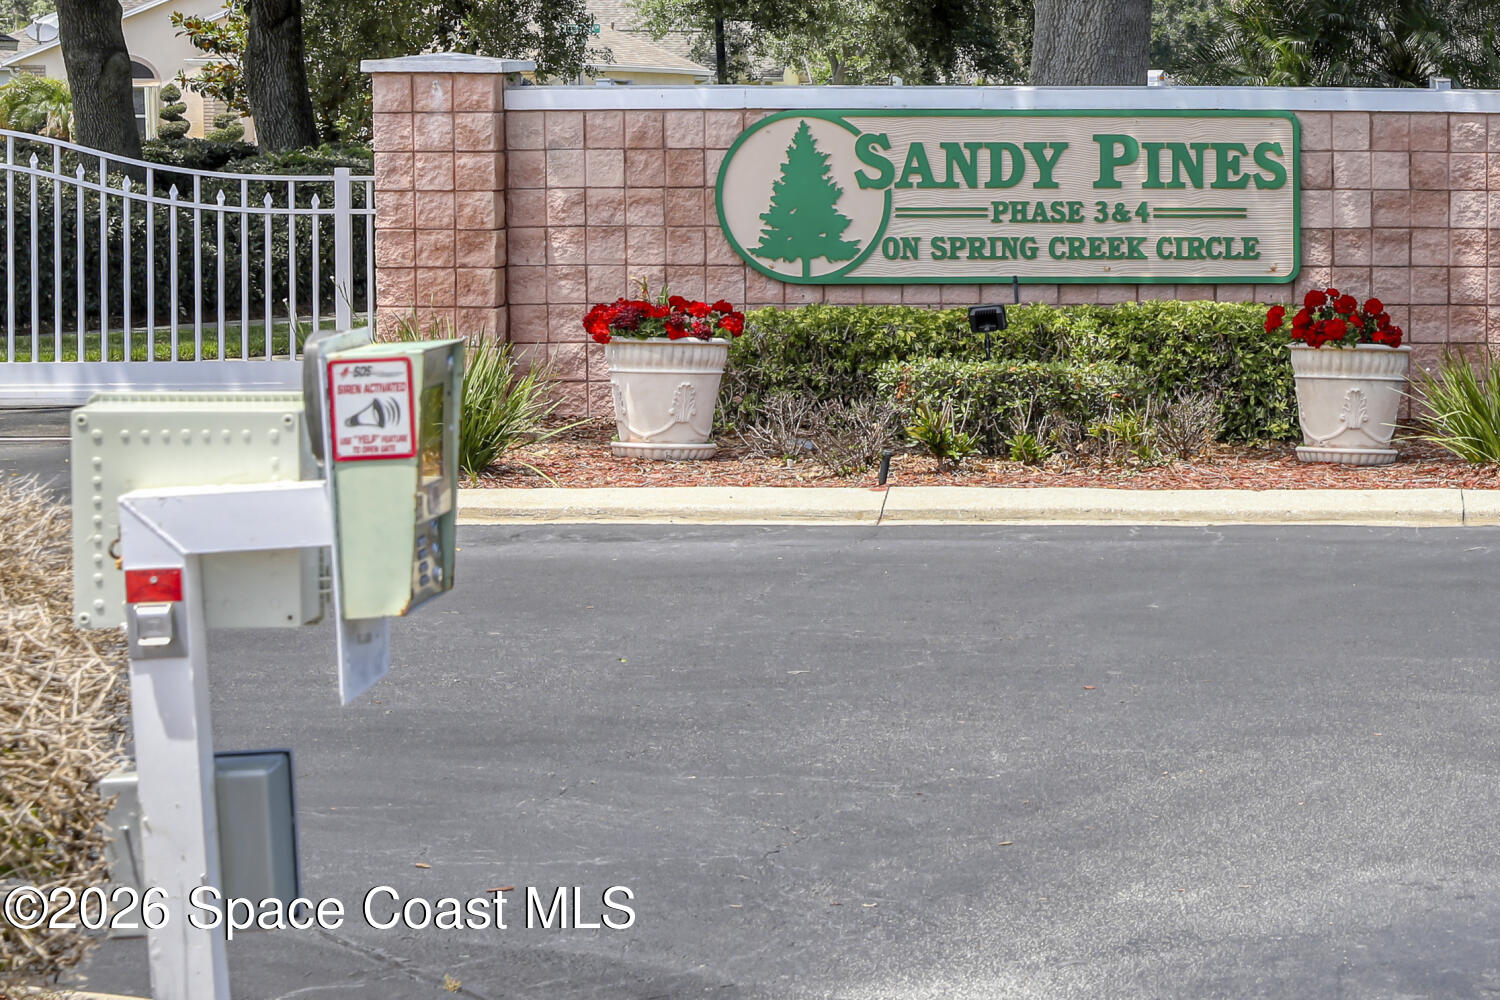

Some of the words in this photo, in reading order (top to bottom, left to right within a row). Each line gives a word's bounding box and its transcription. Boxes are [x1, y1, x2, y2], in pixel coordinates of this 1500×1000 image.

[854, 132, 1069, 190] SANDY
[1093, 133, 1287, 190] PINES
[990, 201, 1085, 224] PHASE
[882, 236, 920, 260] ON
[930, 236, 1038, 261] SPRING
[1048, 236, 1148, 260] CREEK
[1156, 236, 1260, 259] CIRCLE
[337, 384, 362, 395] SIREN
[363, 382, 407, 394] ACTIVATED
